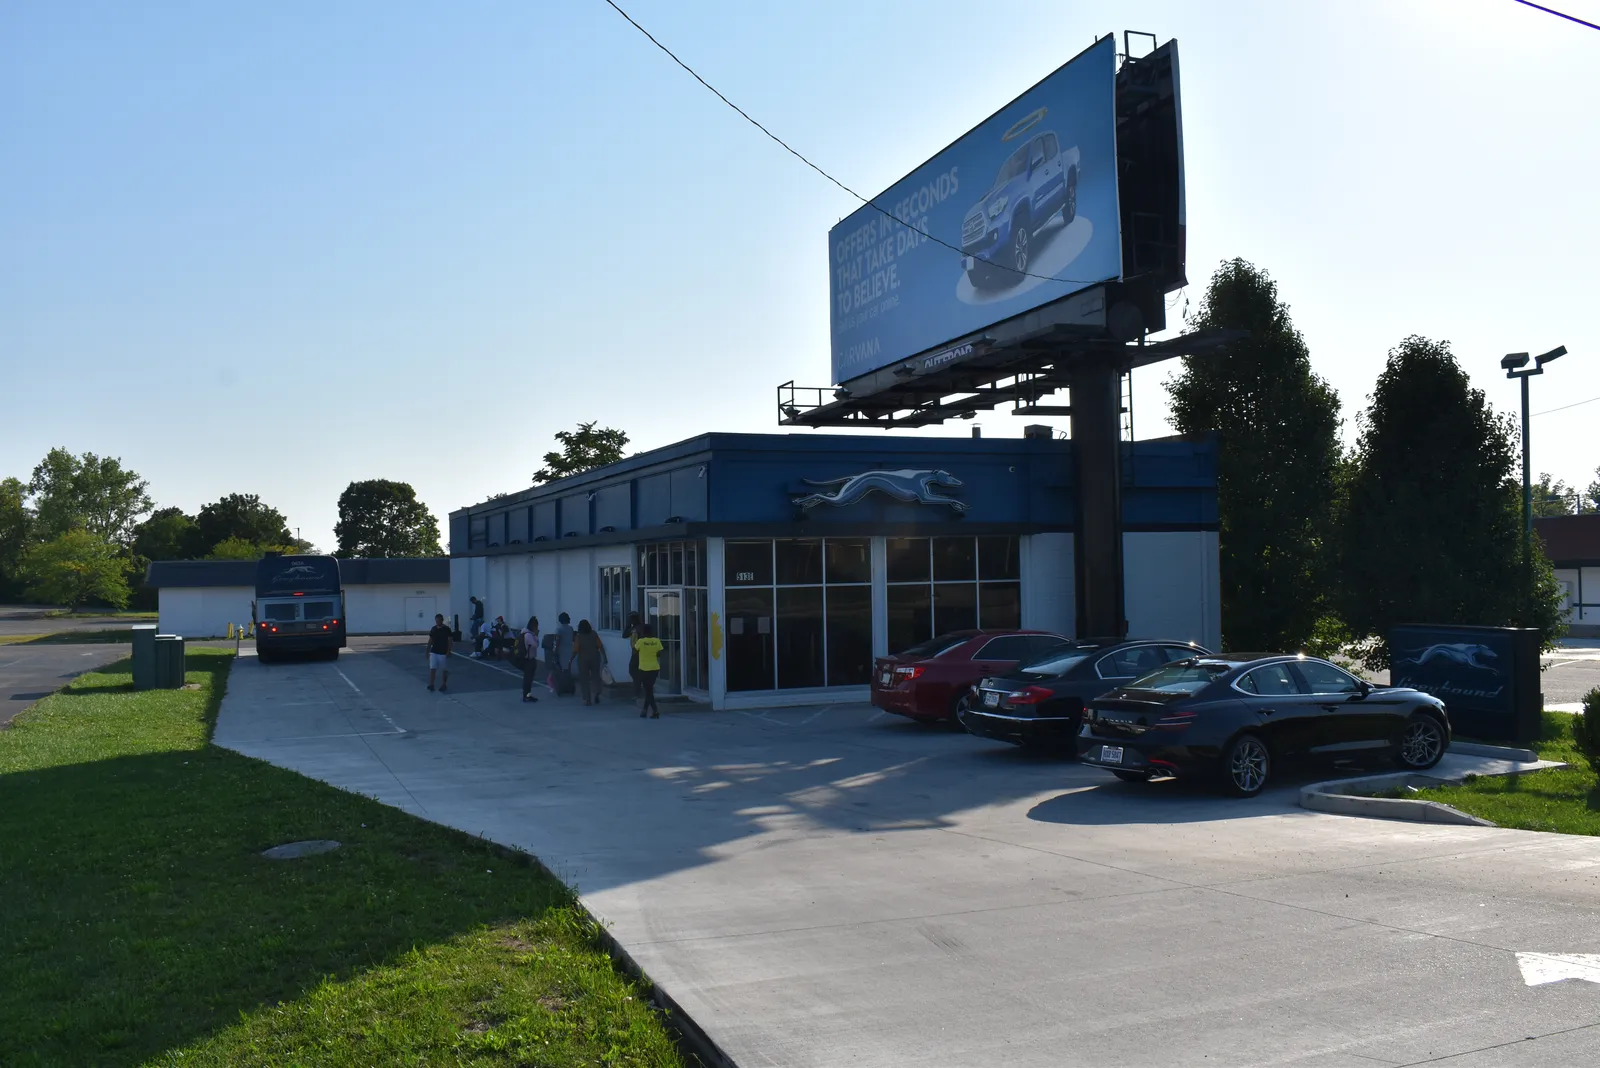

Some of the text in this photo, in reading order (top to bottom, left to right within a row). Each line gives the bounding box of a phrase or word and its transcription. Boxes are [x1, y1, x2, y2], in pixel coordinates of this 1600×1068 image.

[836, 166, 959, 264] OFFERS IN SECONDS
[836, 216, 929, 291] THAT TAKE DAYS
[837, 263, 900, 317] TO BELIEVE.
[837, 336, 881, 370] CARVANA
[1396, 676, 1504, 698] Greyhound
